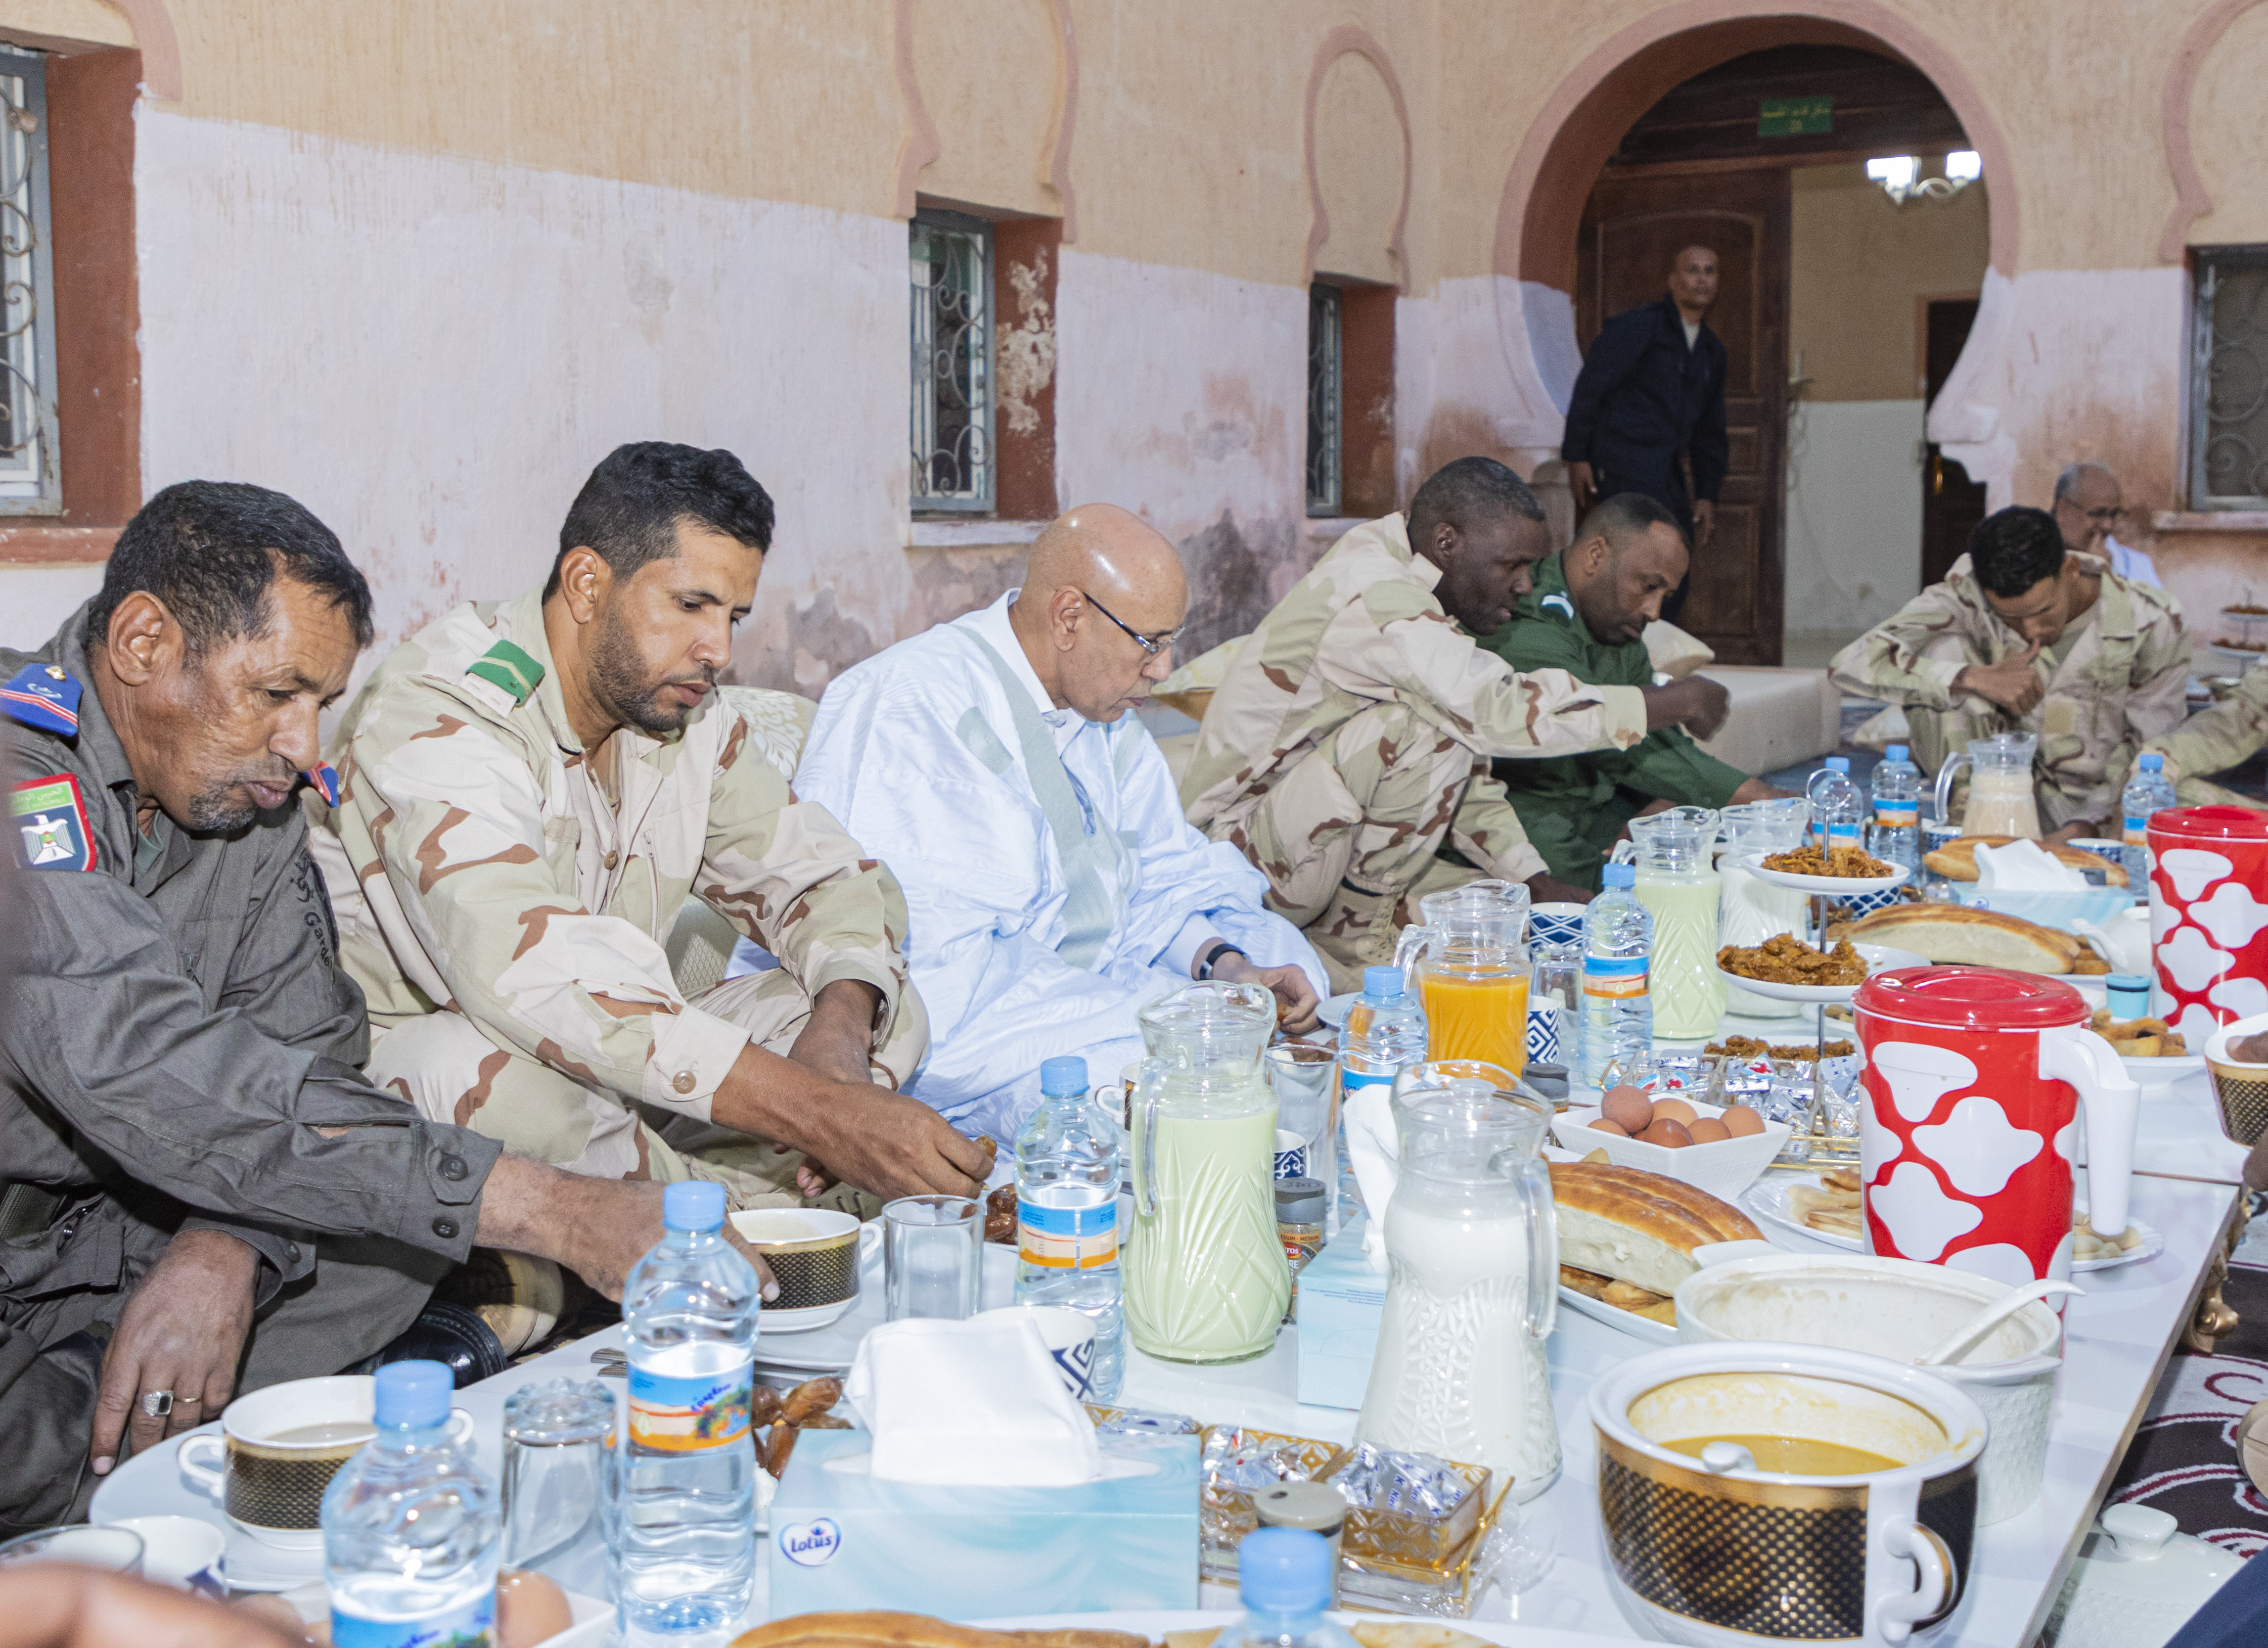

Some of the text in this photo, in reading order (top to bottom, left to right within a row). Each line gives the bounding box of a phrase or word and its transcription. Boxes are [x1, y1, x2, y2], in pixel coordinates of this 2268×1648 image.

[304, 911, 331, 967] Garde
[1388, 1490, 1400, 1509] Kiri
[791, 1536, 832, 1552] Lotus
